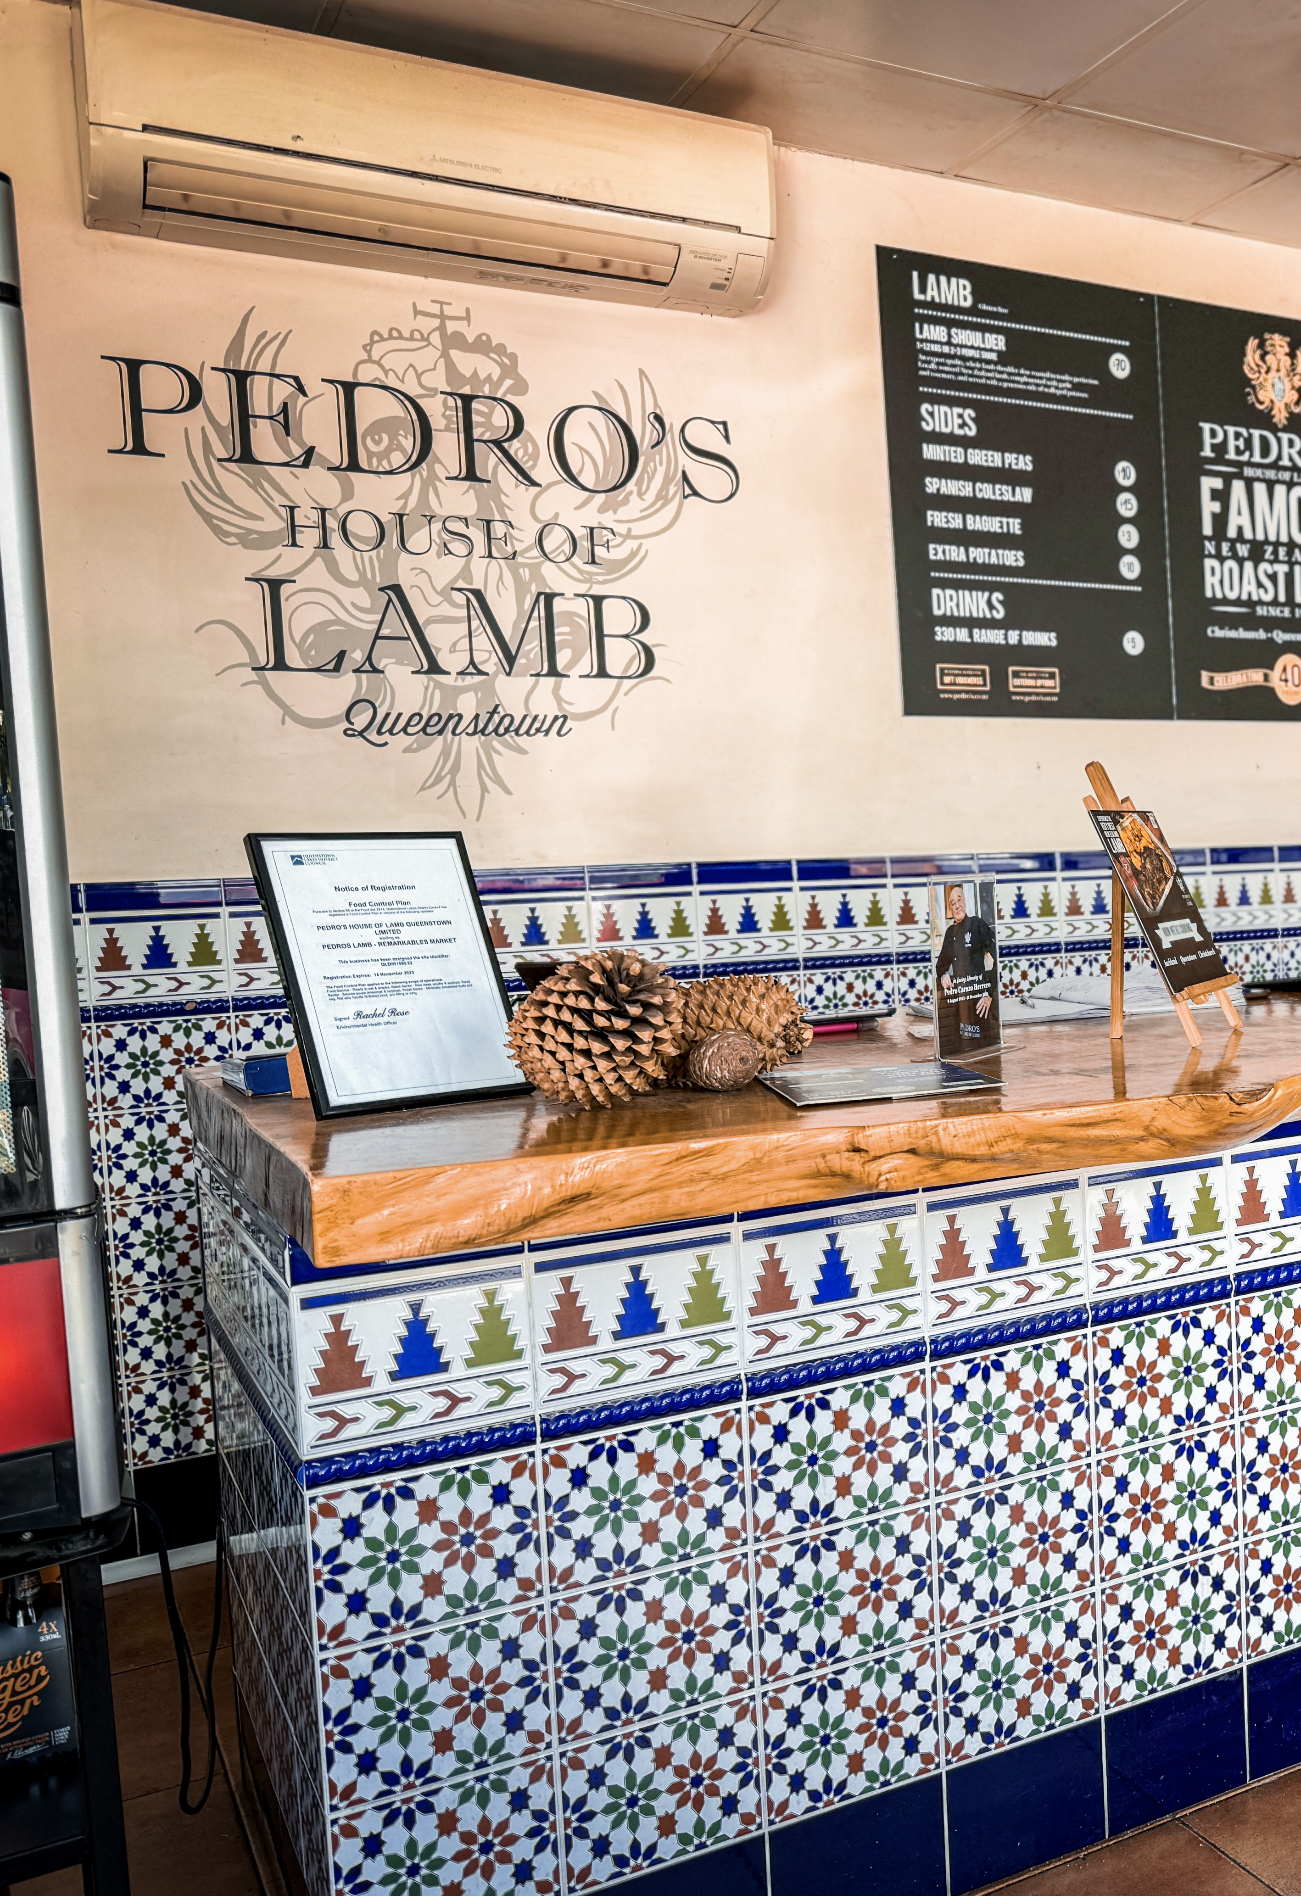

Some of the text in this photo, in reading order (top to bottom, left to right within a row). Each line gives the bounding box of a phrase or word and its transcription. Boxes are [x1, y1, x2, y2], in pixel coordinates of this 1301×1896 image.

[474, 163, 502, 174] ELECTRIC
[912, 270, 973, 308] LAMB
[978, 303, 997, 312] Gluten
[914, 322, 1006, 351] LAMB SHOULDER
[942, 346, 949, 354] OR
[961, 348, 980, 359] PEOPLE
[981, 350, 998, 360] SHARE
[918, 362, 937, 371] Locally
[960, 367, 972, 375] New
[973, 369, 994, 378] Zealand
[982, 362, 995, 370] lamb
[996, 364, 1018, 374] shoulder
[99, 354, 740, 504] PEDRO'S
[920, 403, 977, 437] SIDES
[922, 443, 1033, 472] MINTED GREEN PEAS
[1243, 465, 1277, 480] HOUSE
[1278, 470, 1291, 481] OF
[925, 476, 1033, 504] SPANISH COLESLAW
[926, 510, 1022, 535] FRESH BAGUETTE
[278, 503, 617, 566] HOUSE OF
[928, 543, 1025, 567] EXTRA POTATOES
[1203, 539, 1250, 558] NEW
[1203, 557, 1289, 603] ROAST
[931, 587, 1005, 620] DRINKS
[1255, 605, 1292, 618] SINCE
[244, 575, 657, 680] LAMB
[934, 626, 1058, 647] 330 ML RANGE OF DRINKS
[1207, 626, 1267, 640] Christchurch
[943, 675, 954, 684] GIFT
[1013, 678, 1035, 687] CATERING
[1213, 671, 1264, 687] CELEBRATING
[1278, 663, 1301, 689] 40
[342, 698, 572, 748] Queenstown
[371, 884, 416, 892] Registration
[378, 940, 428, 948] REMARKABLES
[353, 1007, 387, 1020] Rachel
[387, 1007, 410, 1017] Rose
[38, 1621, 58, 1634] 4X
[0, 1650, 43, 1679] ssic
